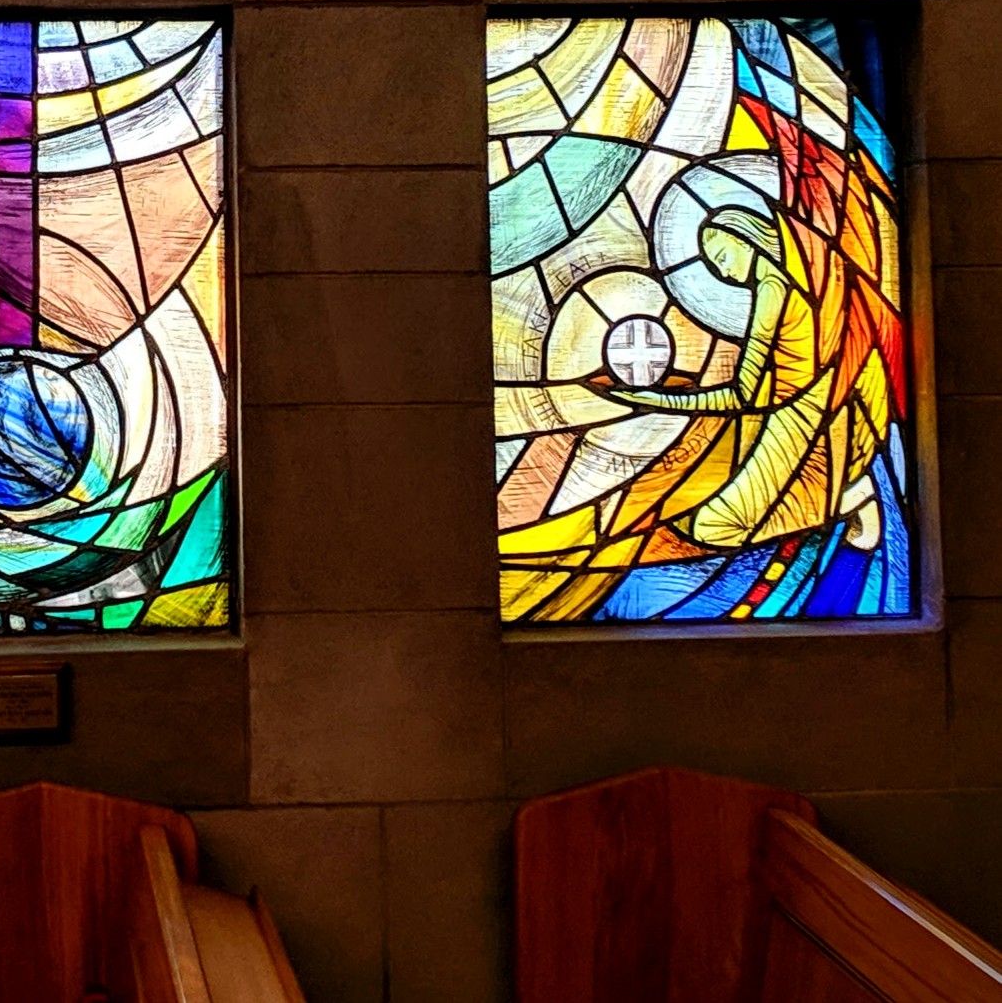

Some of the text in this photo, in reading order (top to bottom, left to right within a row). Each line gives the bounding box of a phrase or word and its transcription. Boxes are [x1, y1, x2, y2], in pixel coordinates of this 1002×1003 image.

[522, 253, 593, 360] TAKE EAT
[662, 425, 713, 472] BODY
